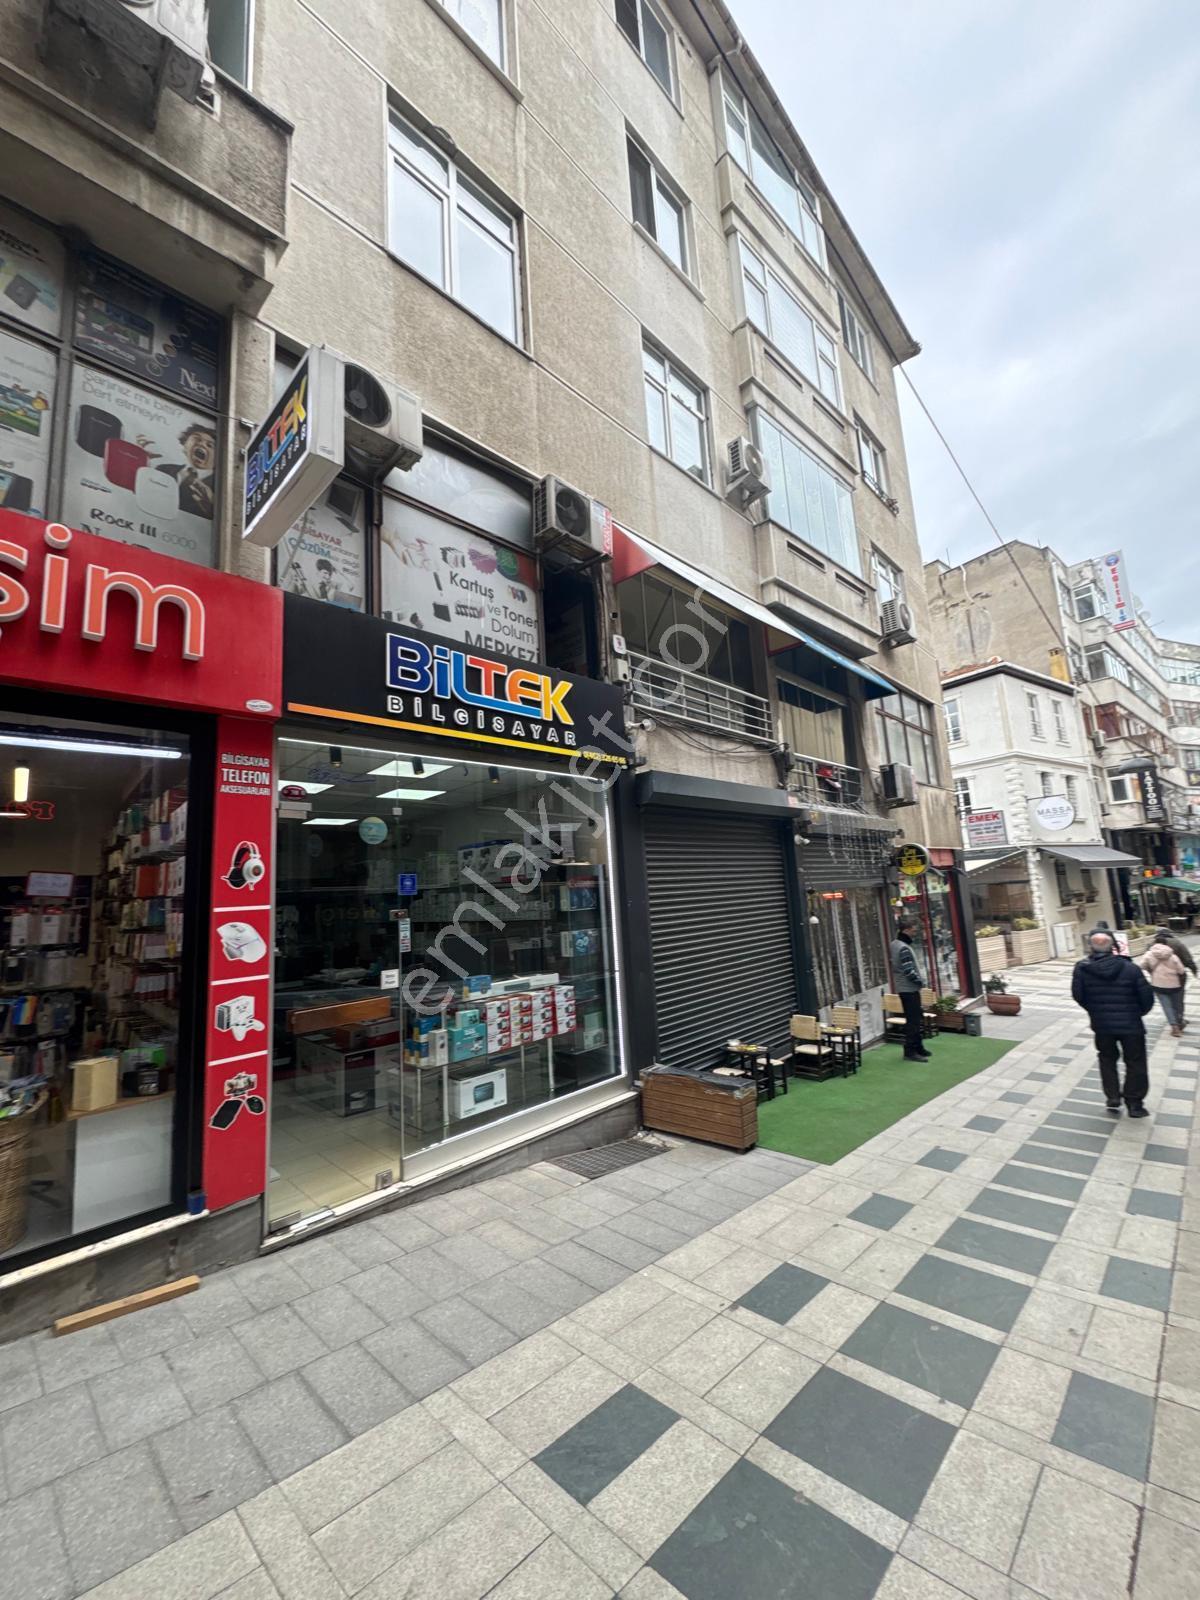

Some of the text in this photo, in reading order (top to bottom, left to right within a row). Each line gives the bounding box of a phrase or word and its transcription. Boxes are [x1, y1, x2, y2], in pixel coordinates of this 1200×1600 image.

[179, 367, 216, 400] Next
[161, 530, 197, 551] 6000
[449, 570, 495, 603] Kartuş
[487, 603, 539, 628] ve Toner
[490, 617, 535, 645] Dolum
[386, 694, 577, 746] BİLGİSAYAR
[221, 751, 270, 768] BİLGİSAYAR
[221, 767, 270, 785] TELEFON
[1143, 771, 1159, 805] TATTOO
[968, 812, 1000, 824] EMEK
[1036, 806, 1073, 816] MASSA
